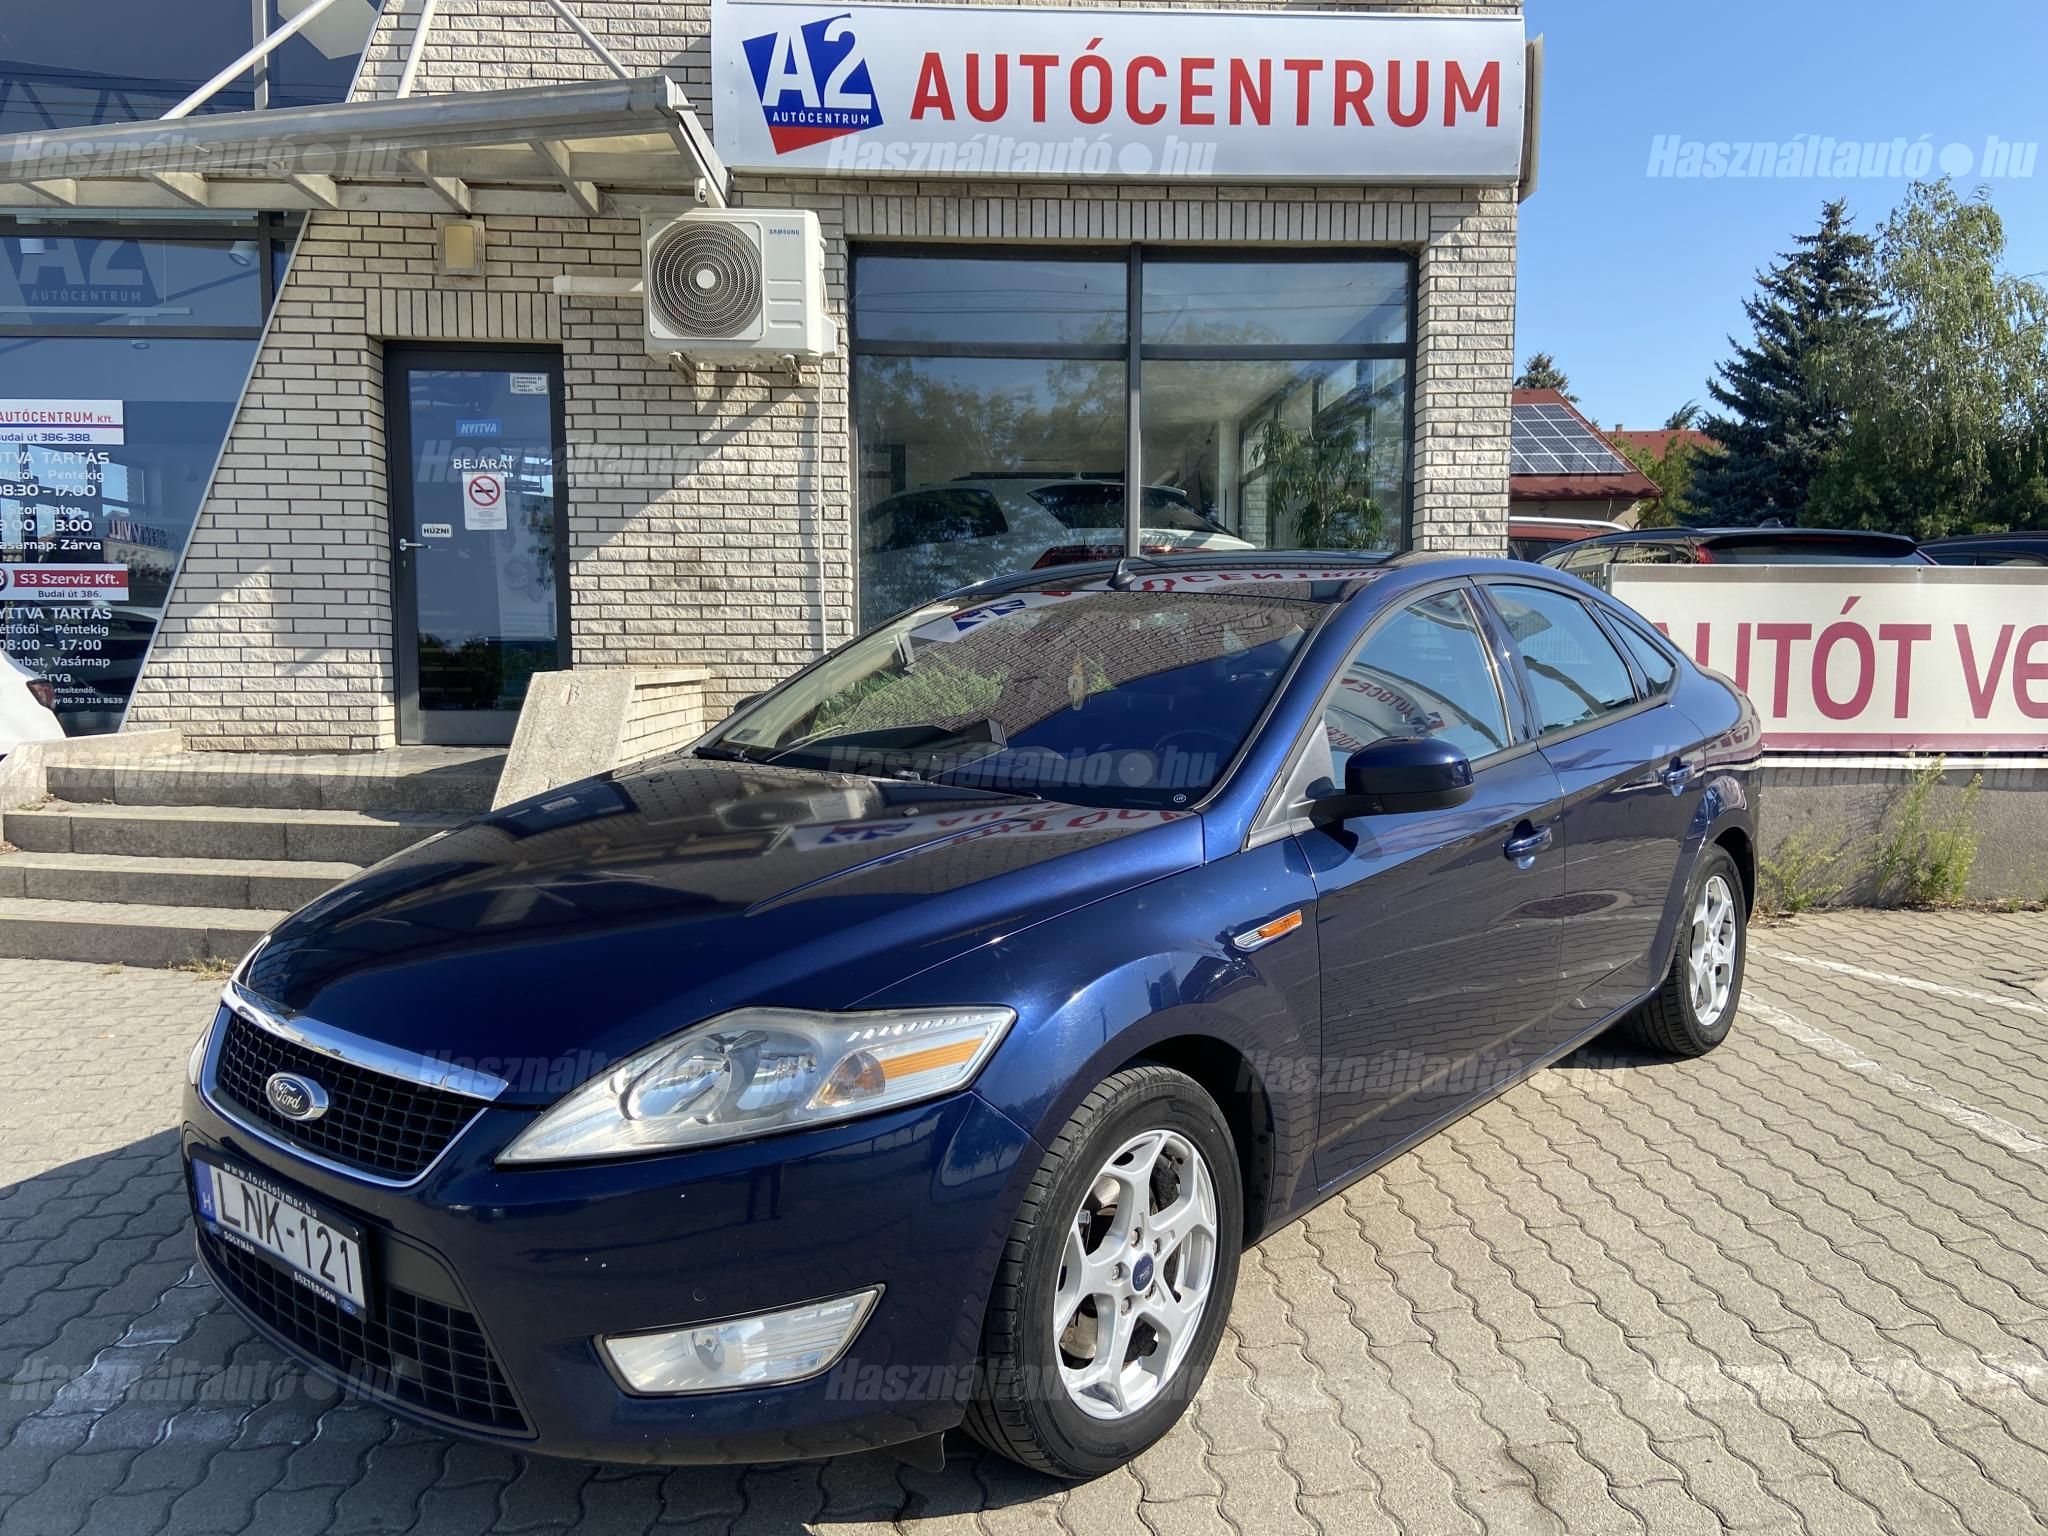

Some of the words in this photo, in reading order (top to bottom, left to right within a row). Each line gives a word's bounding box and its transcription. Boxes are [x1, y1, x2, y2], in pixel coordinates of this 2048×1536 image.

[761, 15, 871, 110] A2
[910, 37, 1501, 127] AUTÓCENTRUM
[772, 110, 870, 125] AUTÓCENTRUM
[769, 228, 800, 236] SAMSUNG
[31, 287, 141, 302] AUTÓCENTRUM
[461, 424, 497, 434] NYITVA
[0, 433, 23, 441] udai
[41, 433, 93, 442] 386-388.
[453, 456, 514, 469] BEJÁRAT
[0, 484, 39, 496] 8:30
[0, 539, 57, 551] asárnap:
[60, 539, 101, 550] Zárva
[20, 574, 38, 584] S3
[41, 573, 91, 584] Szerviz
[95, 574, 120, 584] Kft.
[38, 590, 64, 598] Budai
[68, 590, 78, 598] út
[81, 590, 102, 598] 386.
[55, 625, 109, 636] Péntekig
[0, 639, 40, 650] 08:00
[60, 639, 102, 650] 17:00
[52, 656, 111, 668] Vasárnap
[1653, 596, 1932, 719] UTÓT
[40, 670, 72, 682] árva
[275, 1081, 302, 1110] Ford
[202, 1191, 212, 1212] H
[217, 1171, 353, 1294] LNK-121
